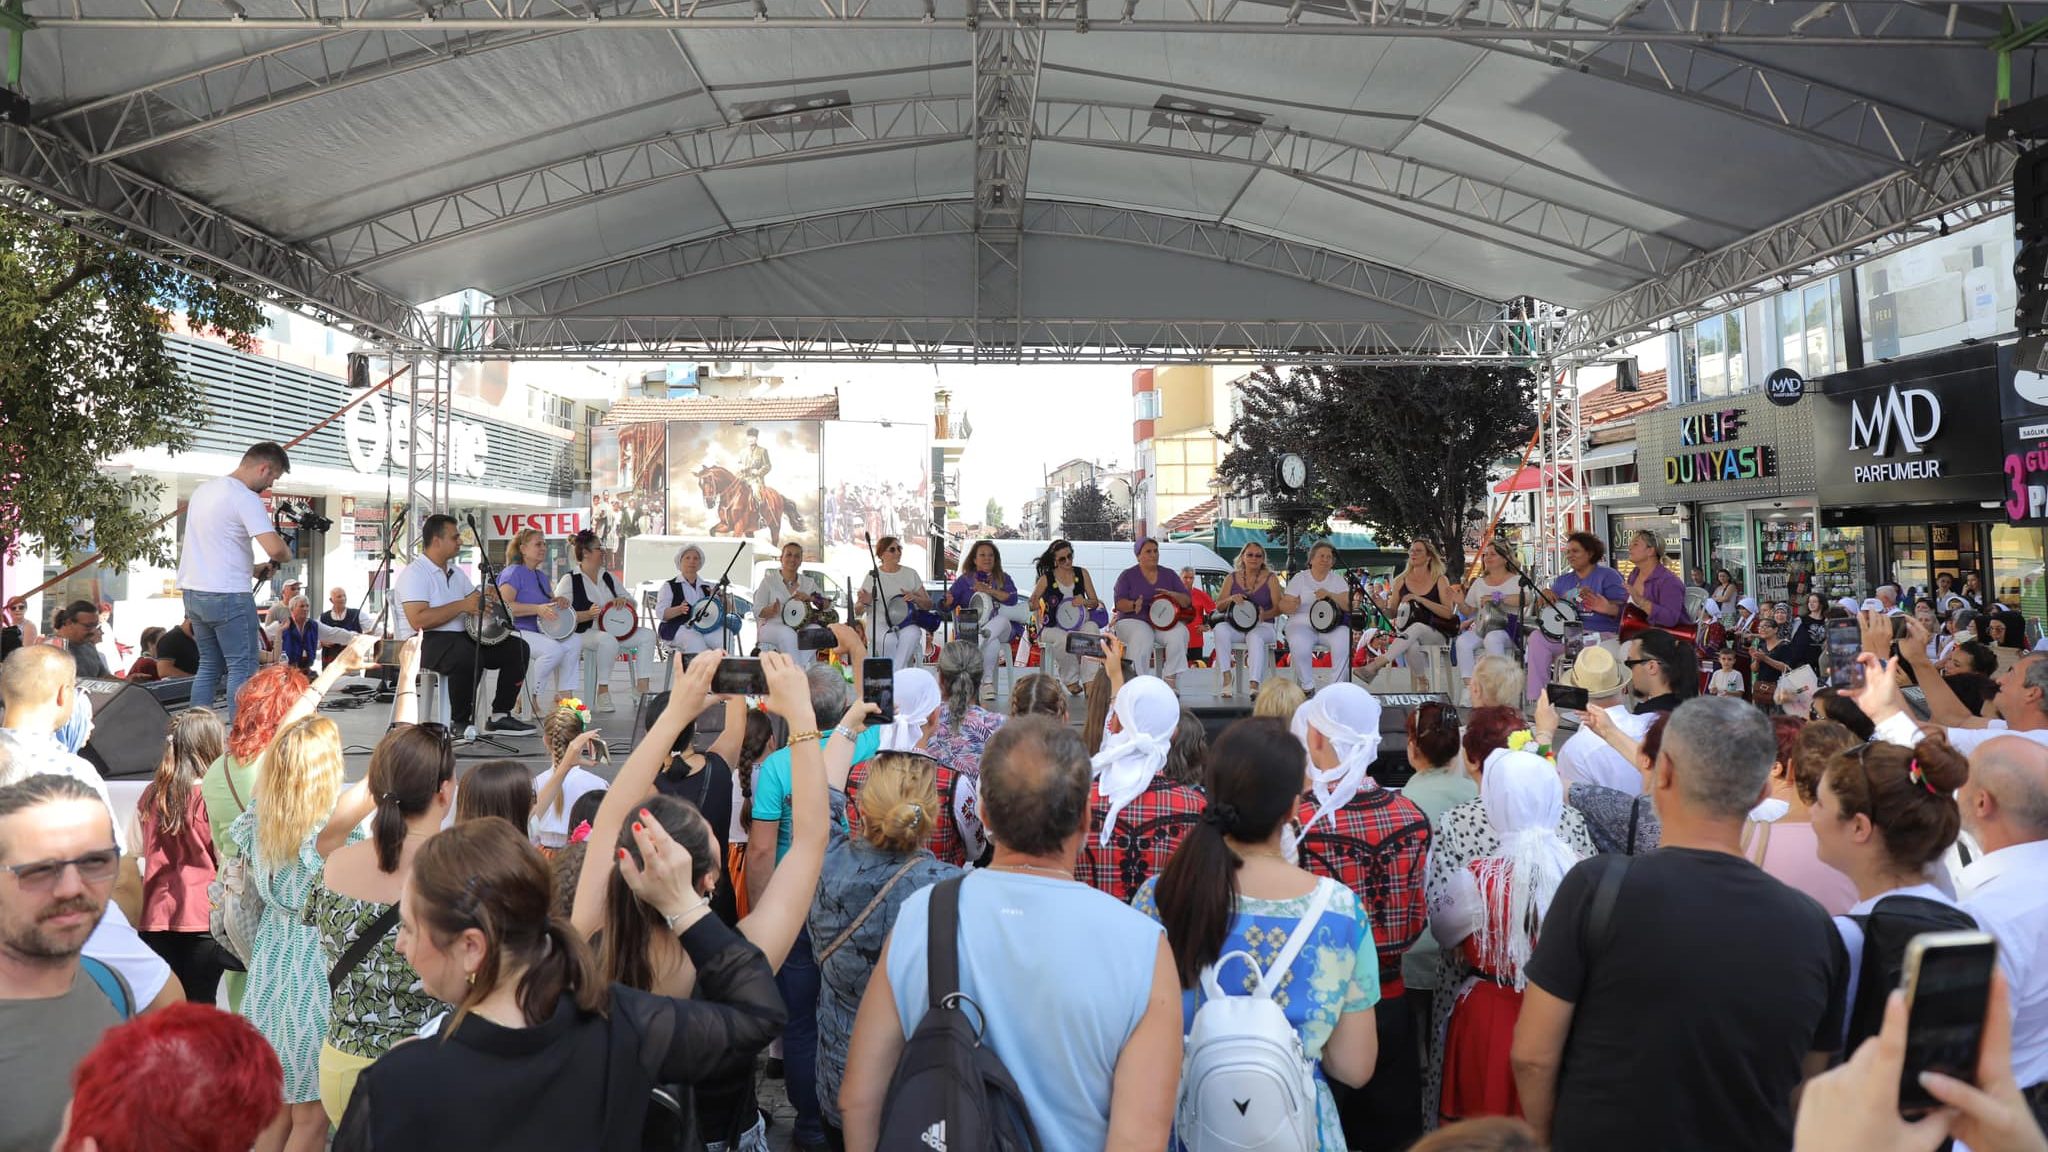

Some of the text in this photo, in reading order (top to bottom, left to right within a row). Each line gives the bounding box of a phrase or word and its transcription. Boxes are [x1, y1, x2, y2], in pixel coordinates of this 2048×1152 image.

[1772, 377, 1801, 393] MAD
[1681, 409, 1735, 446] KILIF
[1849, 385, 1941, 456] MAD
[1855, 460, 1940, 482] PARFUMEUR
[2004, 454, 2027, 520] 3
[2028, 485, 2048, 518] P
[493, 513, 581, 535] VESTEL
